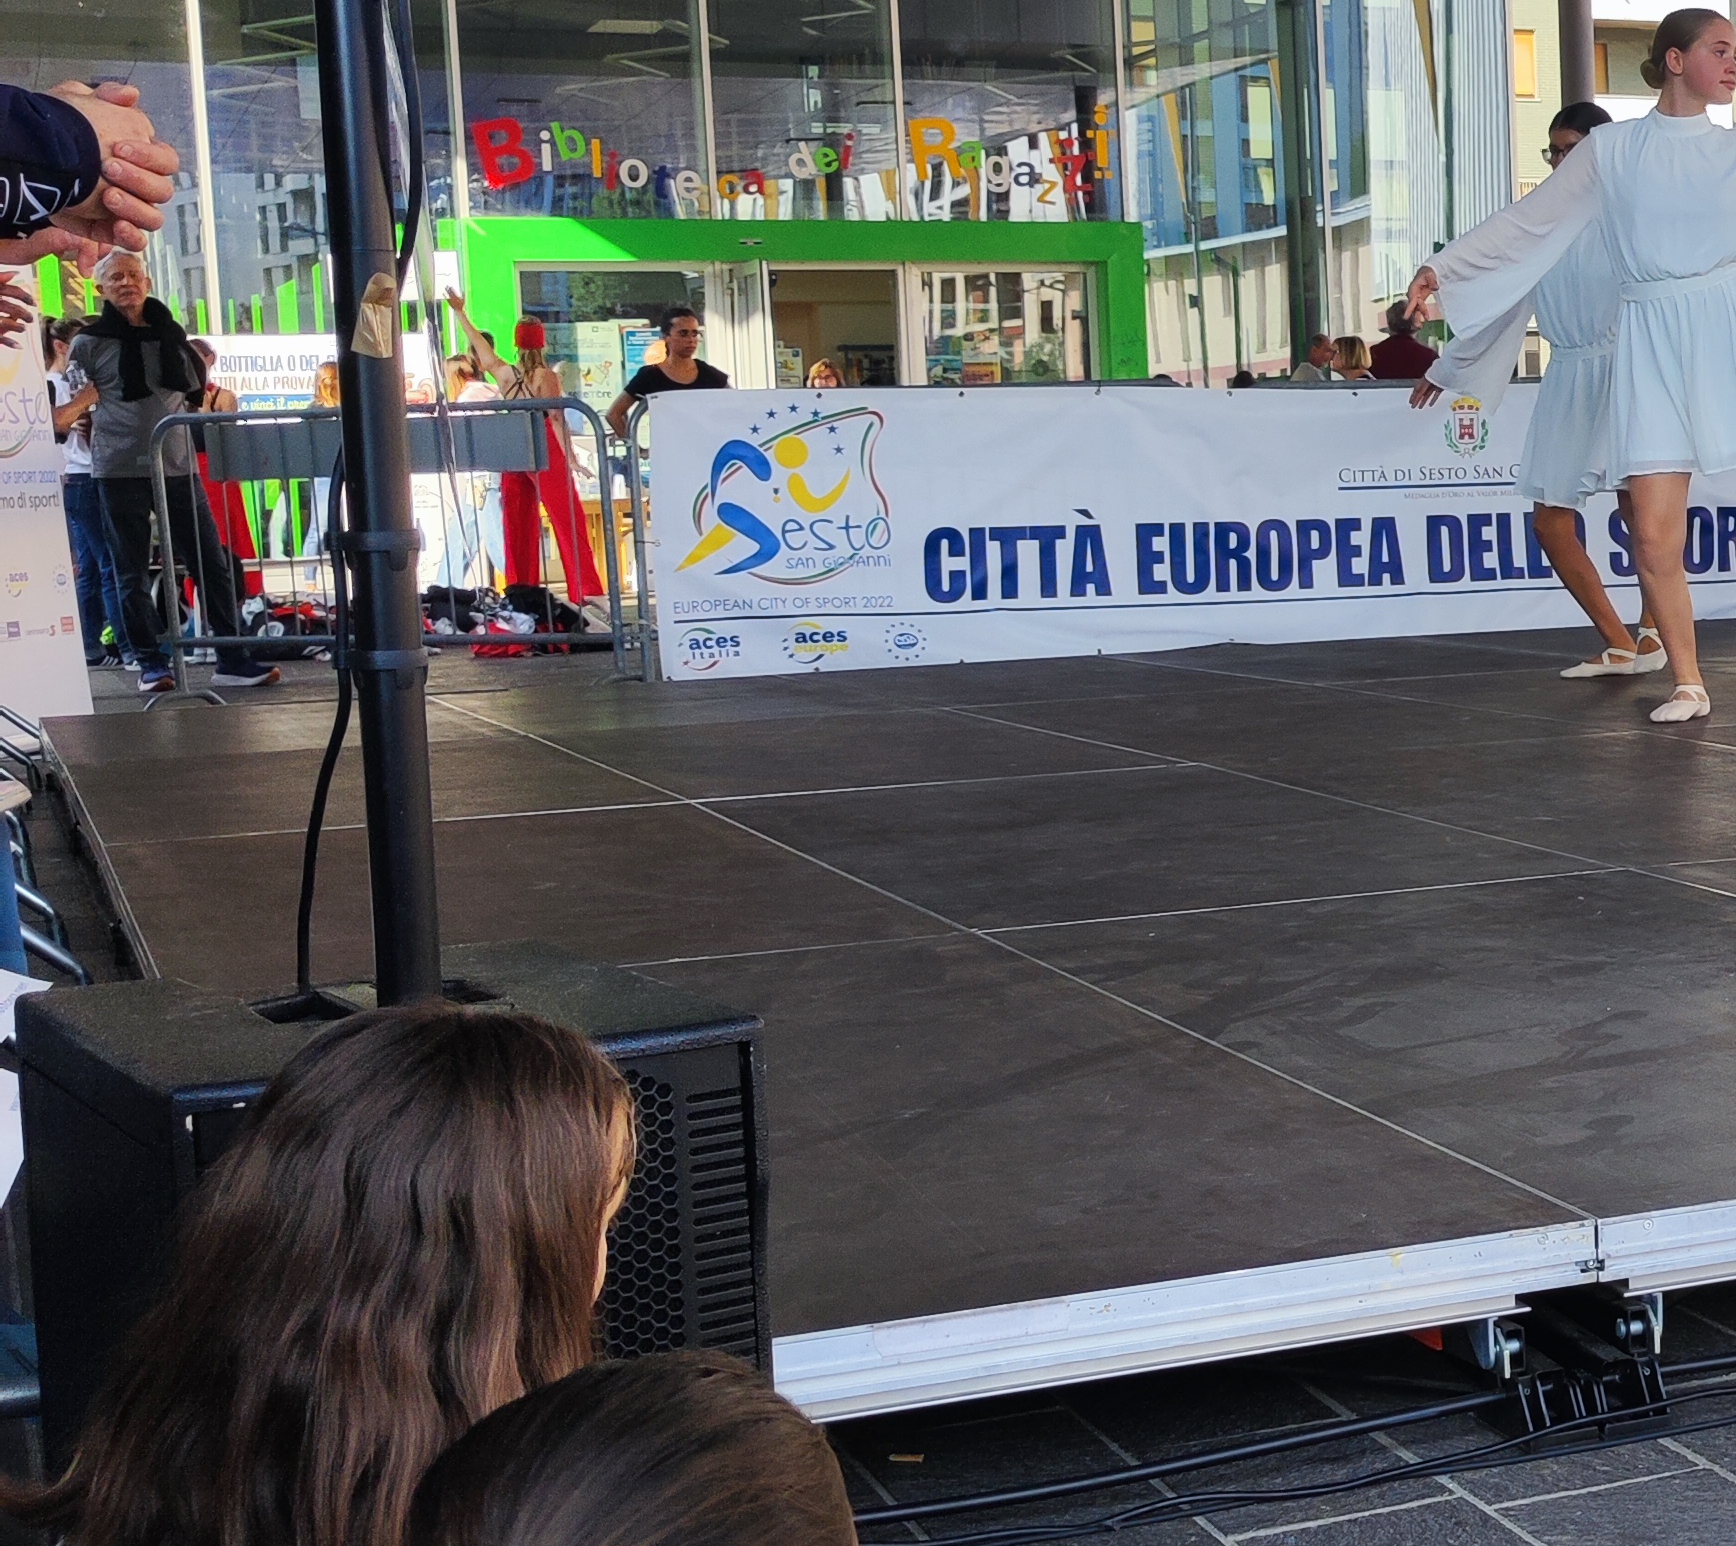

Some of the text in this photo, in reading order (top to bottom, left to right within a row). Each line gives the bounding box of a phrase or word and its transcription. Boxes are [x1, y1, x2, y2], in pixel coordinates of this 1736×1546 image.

[470, 103, 1115, 205] Biblioteca dei Ragazzi
[220, 355, 284, 373] BOTTIGLIA
[29, 491, 60, 513] sport!
[923, 508, 1113, 604] CITTÀ
[1134, 515, 1406, 596] EUROPEA
[673, 594, 895, 615] EUROPEAN CITY OF SPORT 2022
[688, 634, 742, 652] aces
[794, 629, 849, 644] aces
[793, 643, 850, 655] europe
